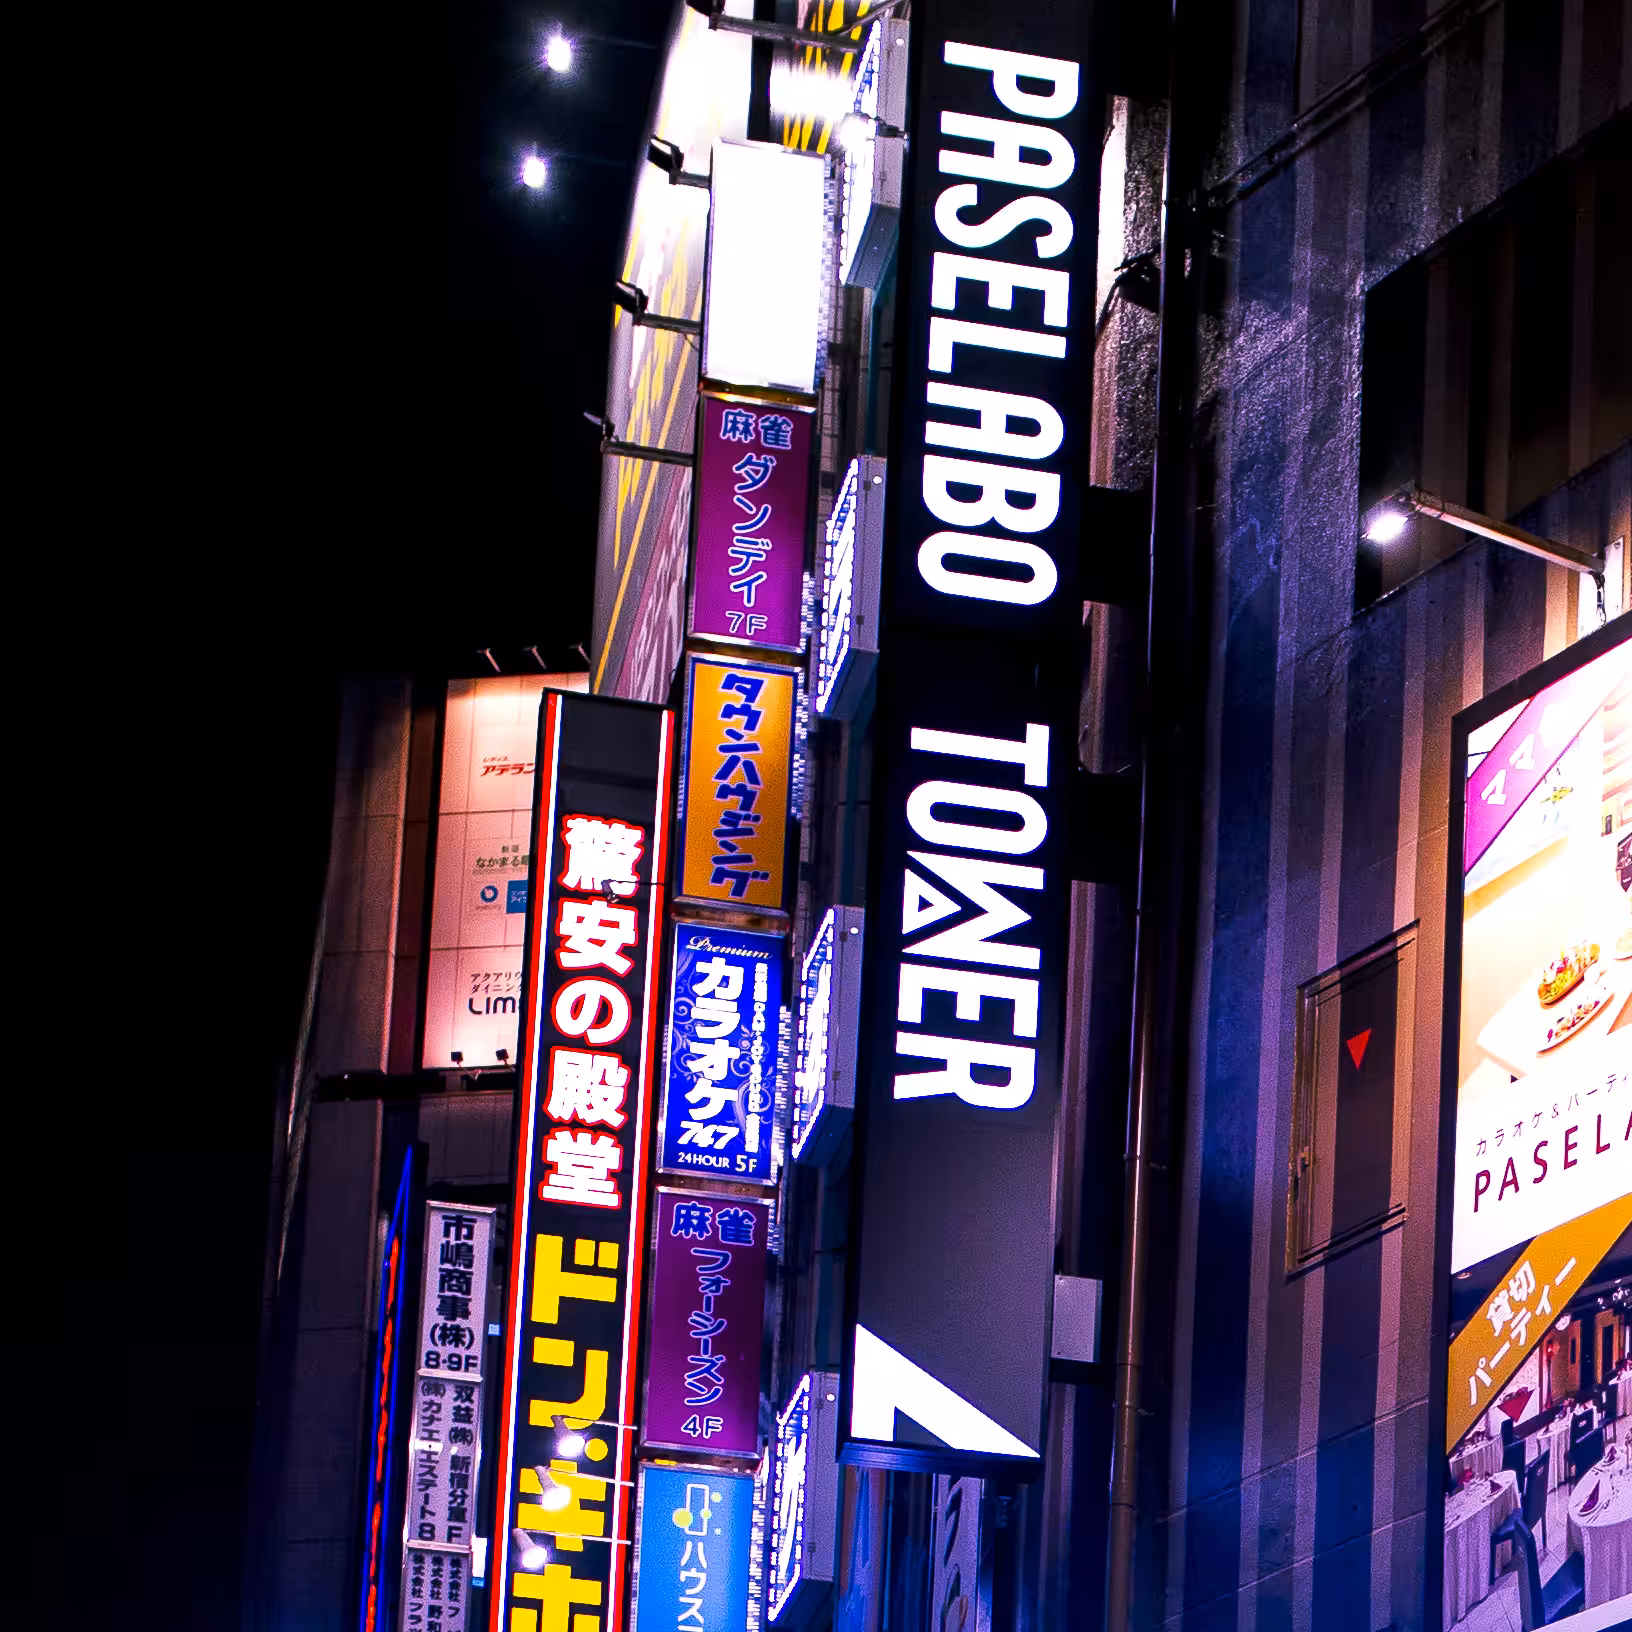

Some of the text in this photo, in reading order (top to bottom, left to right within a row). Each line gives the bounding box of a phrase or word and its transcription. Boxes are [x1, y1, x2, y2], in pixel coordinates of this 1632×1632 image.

[720, 408, 793, 450] 麻雀
[724, 452, 778, 608] ダンディ
[893, 40, 1080, 1110] PASELABO TOWER
[724, 610, 768, 636] 7F
[711, 673, 769, 899] タウンハウジング
[685, 935, 773, 960] Premium
[468, 996, 520, 1015] LIM
[540, 814, 645, 1209] 驚安の殿堂
[685, 956, 745, 1120] カラオケ
[677, 1120, 740, 1150] 747
[677, 1151, 758, 1173] 24HOUR 5F
[670, 1201, 756, 1247] 麻雀
[684, 1247, 732, 1407] フォーシーズン
[1484, 1258, 1537, 1338] 貸切
[1468, 1256, 1577, 1406] パーティー
[680, 1414, 724, 1440] 4F
